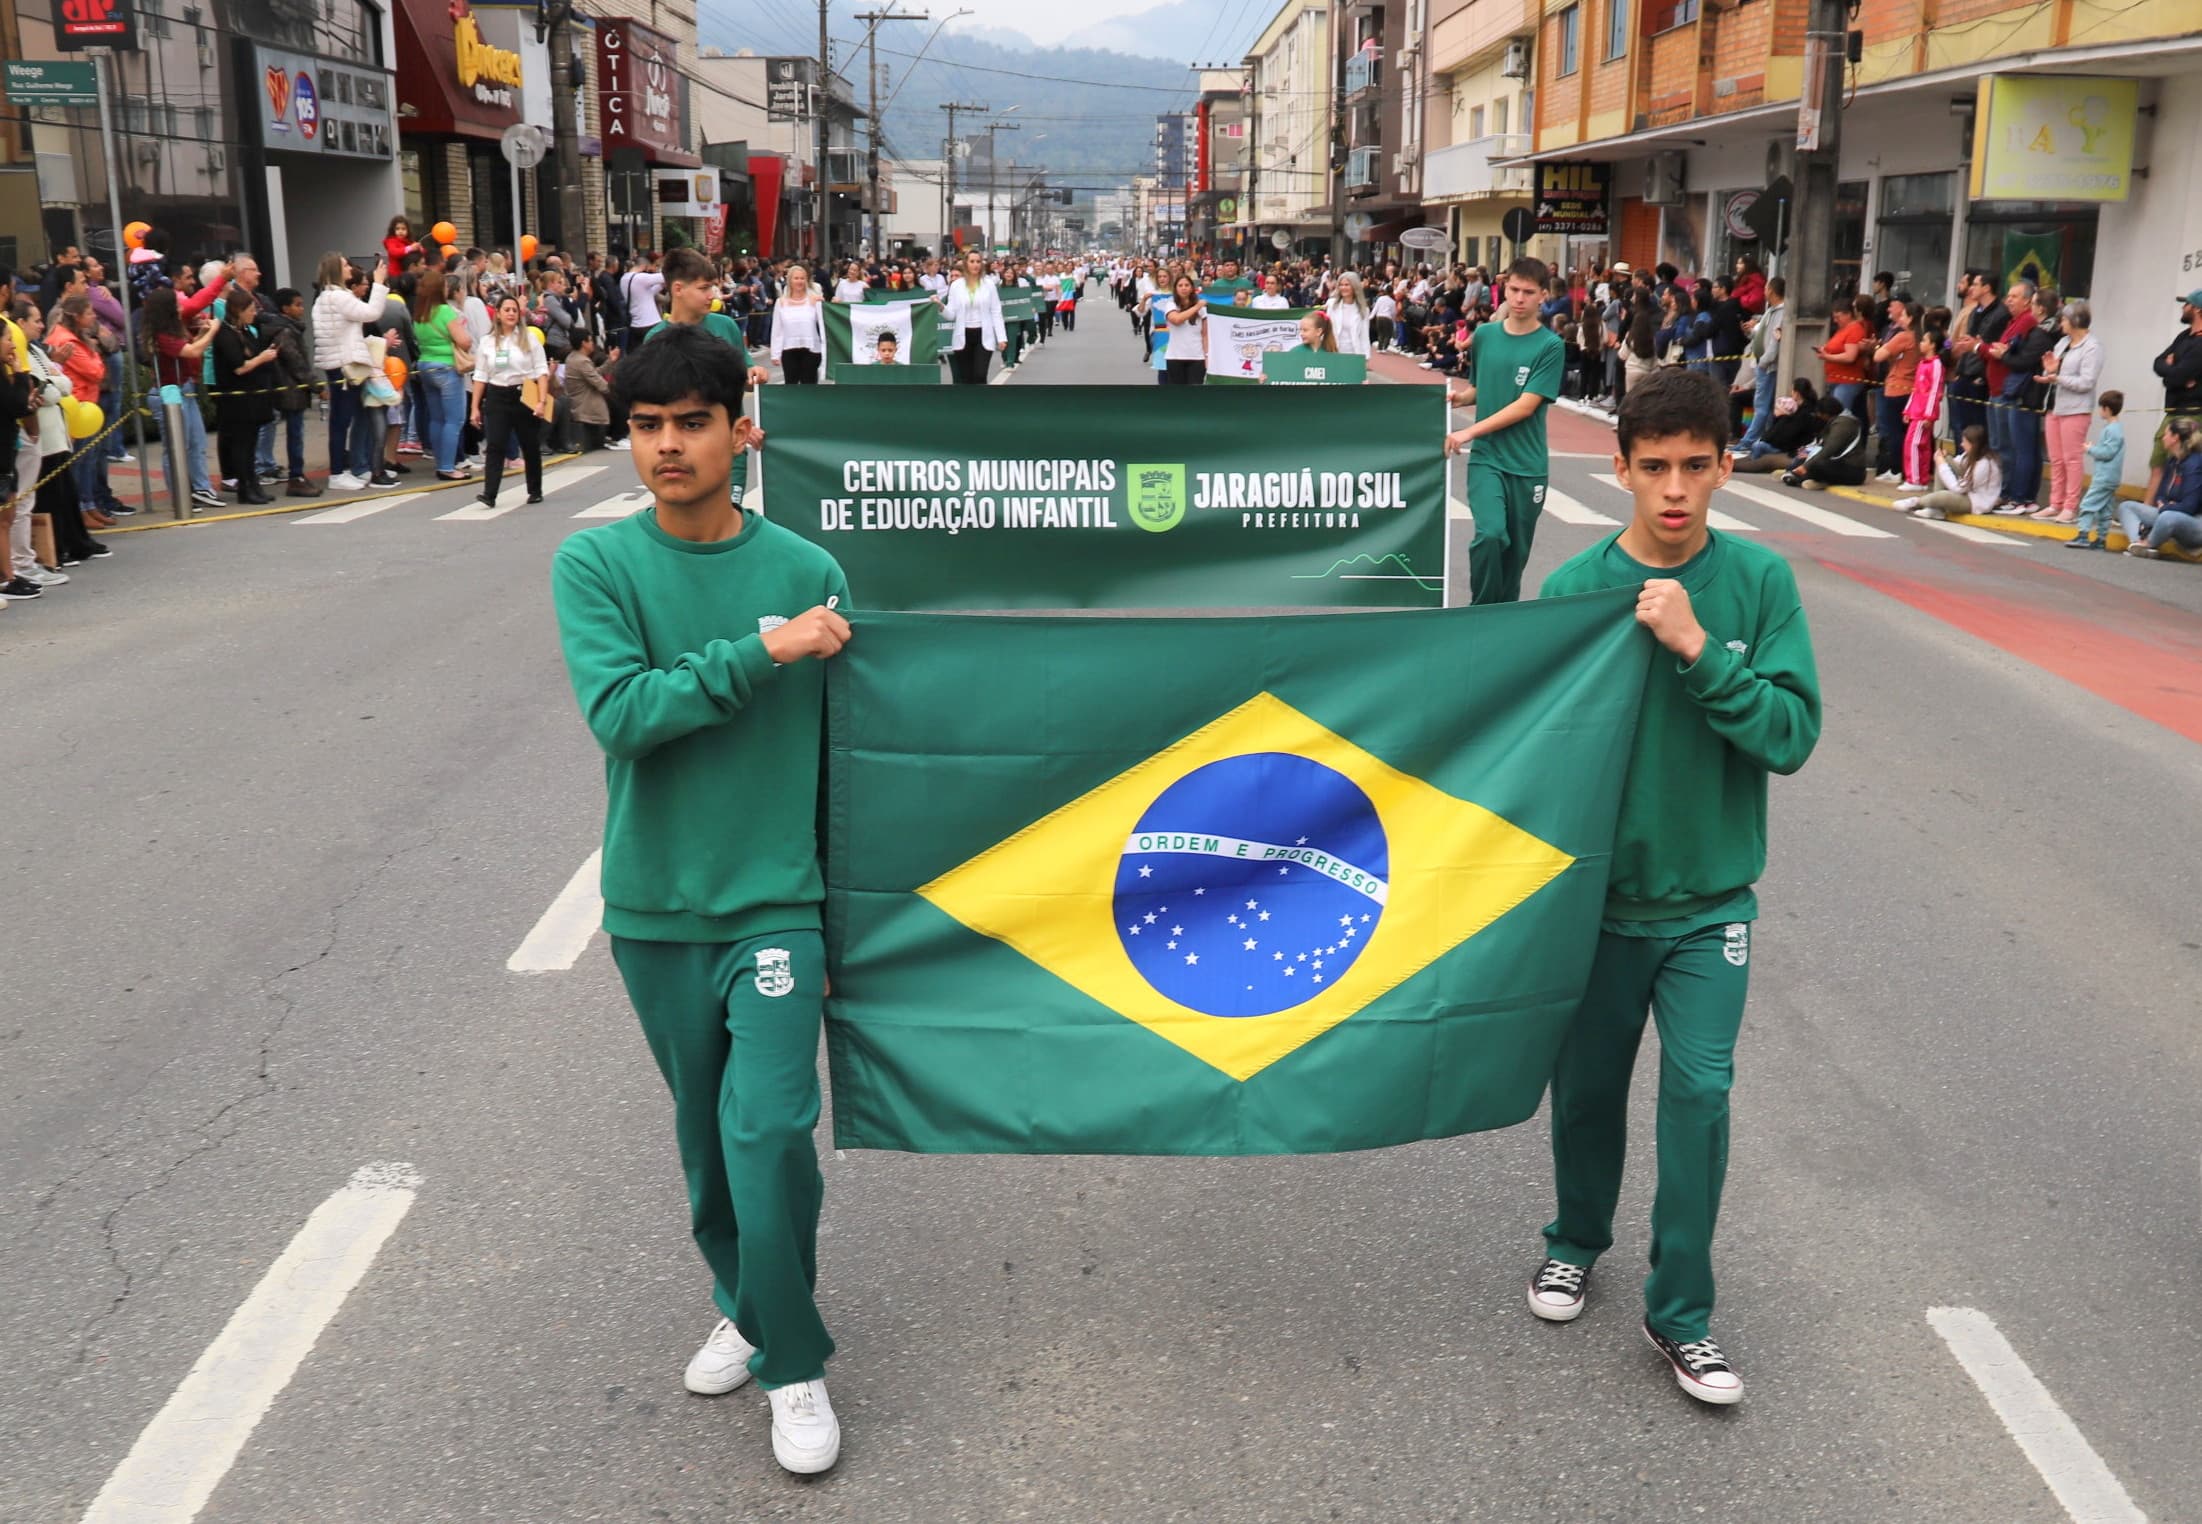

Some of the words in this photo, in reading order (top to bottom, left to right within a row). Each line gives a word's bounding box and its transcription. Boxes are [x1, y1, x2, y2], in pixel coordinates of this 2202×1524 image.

[8, 64, 44, 78] Weege
[604, 29, 625, 134] ÓTICA
[296, 97, 315, 121] 105
[1543, 166, 1602, 190] HIL
[843, 460, 961, 492] CENTROS
[968, 460, 1116, 492] MUNICIPAIS
[1193, 467, 1315, 509] JARAGUÁ
[1320, 472, 1354, 508] DO
[1358, 472, 1407, 508] SUL
[820, 498, 854, 531] DE
[861, 490, 995, 535] EDUCAÇÃO
[1003, 496, 1117, 529] INFANTIL
[1242, 513, 1361, 528] PREFEITURA
[1140, 836, 1219, 851] ORDEM
[1237, 843, 1248, 856] E
[1263, 847, 1378, 895] PROGRESSO
